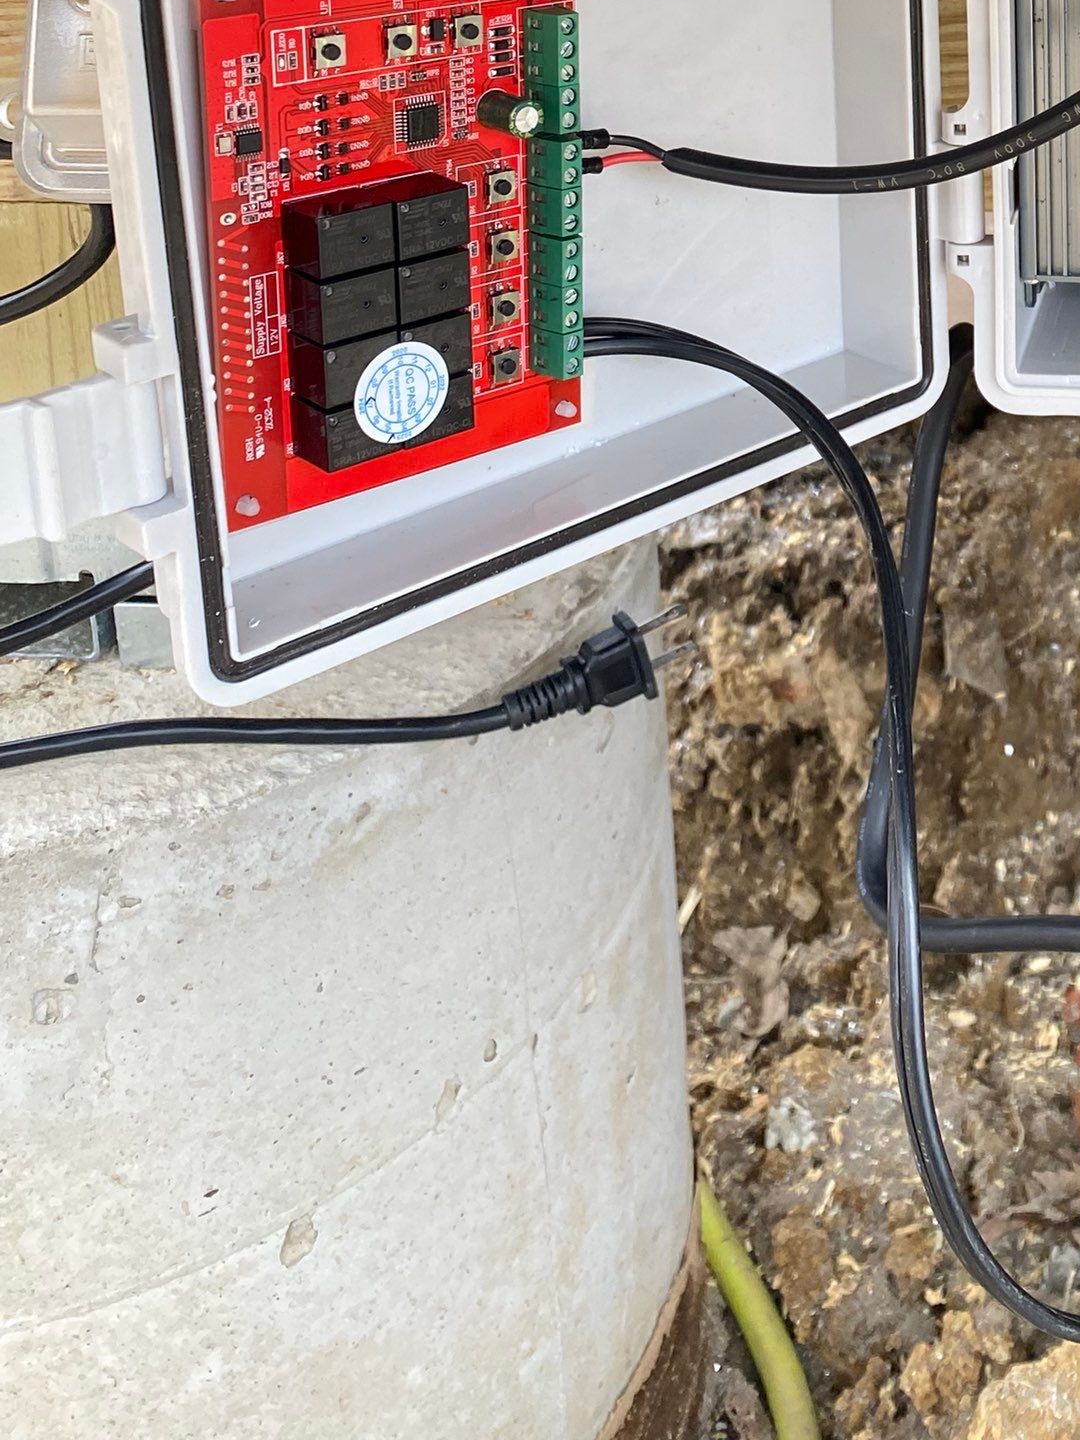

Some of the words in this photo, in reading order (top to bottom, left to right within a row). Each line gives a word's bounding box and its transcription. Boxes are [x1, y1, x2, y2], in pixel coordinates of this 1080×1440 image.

[320, 1, 328, 15] UP
[993, 131, 1037, 160] 300V
[267, 161, 279, 169] C12
[267, 180, 279, 189] C13
[851, 177, 899, 190] VW-1
[253, 278, 264, 316] Voltage
[256, 321, 266, 355] Supply
[270, 328, 279, 346] 12V
[405, 367, 415, 384] QC
[430, 380, 437, 388] 01
[406, 387, 417, 415] PASS
